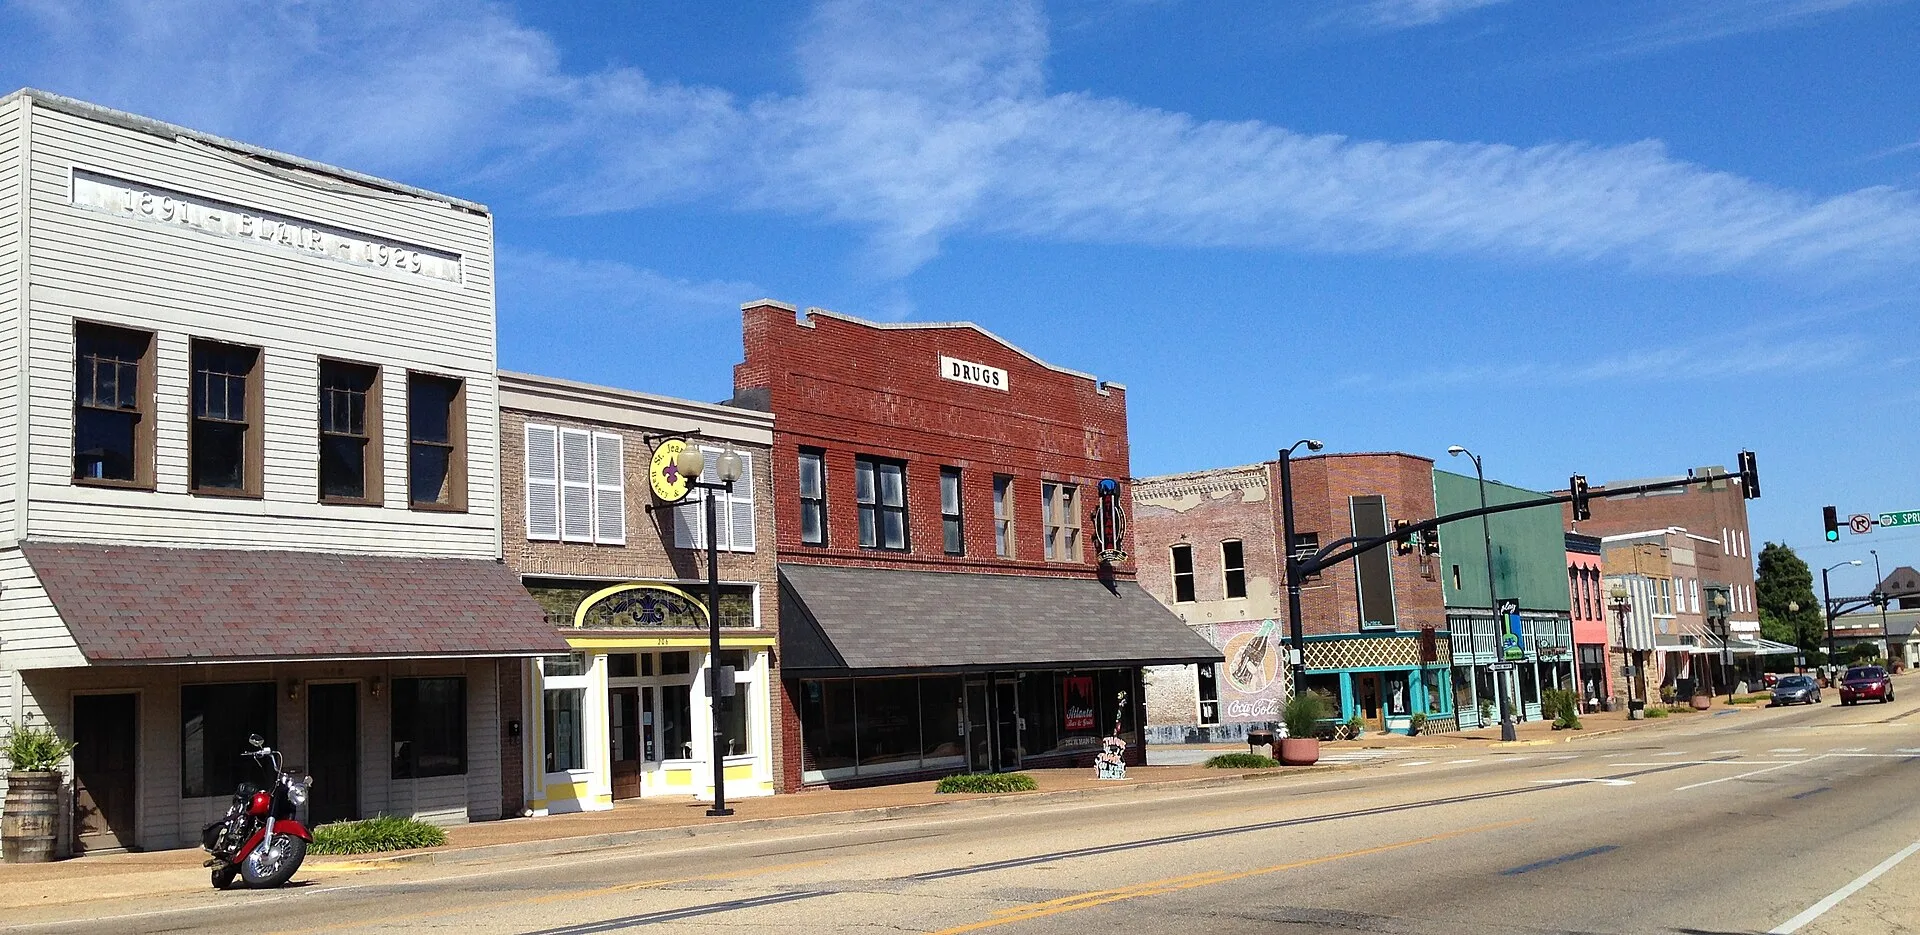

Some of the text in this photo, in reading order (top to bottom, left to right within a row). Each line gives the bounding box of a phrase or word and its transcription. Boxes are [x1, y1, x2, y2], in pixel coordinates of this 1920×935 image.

[123, 188, 189, 224] 1891
[238, 213, 325, 252] BLAIR
[365, 242, 423, 275] 1929
[952, 361, 1000, 387] DRUGS
[651, 470, 669, 499] Bakery
[1892, 514, 1897, 524] S
[1066, 705, 1093, 719] Atlanta
[1066, 719, 1077, 727] Bar
